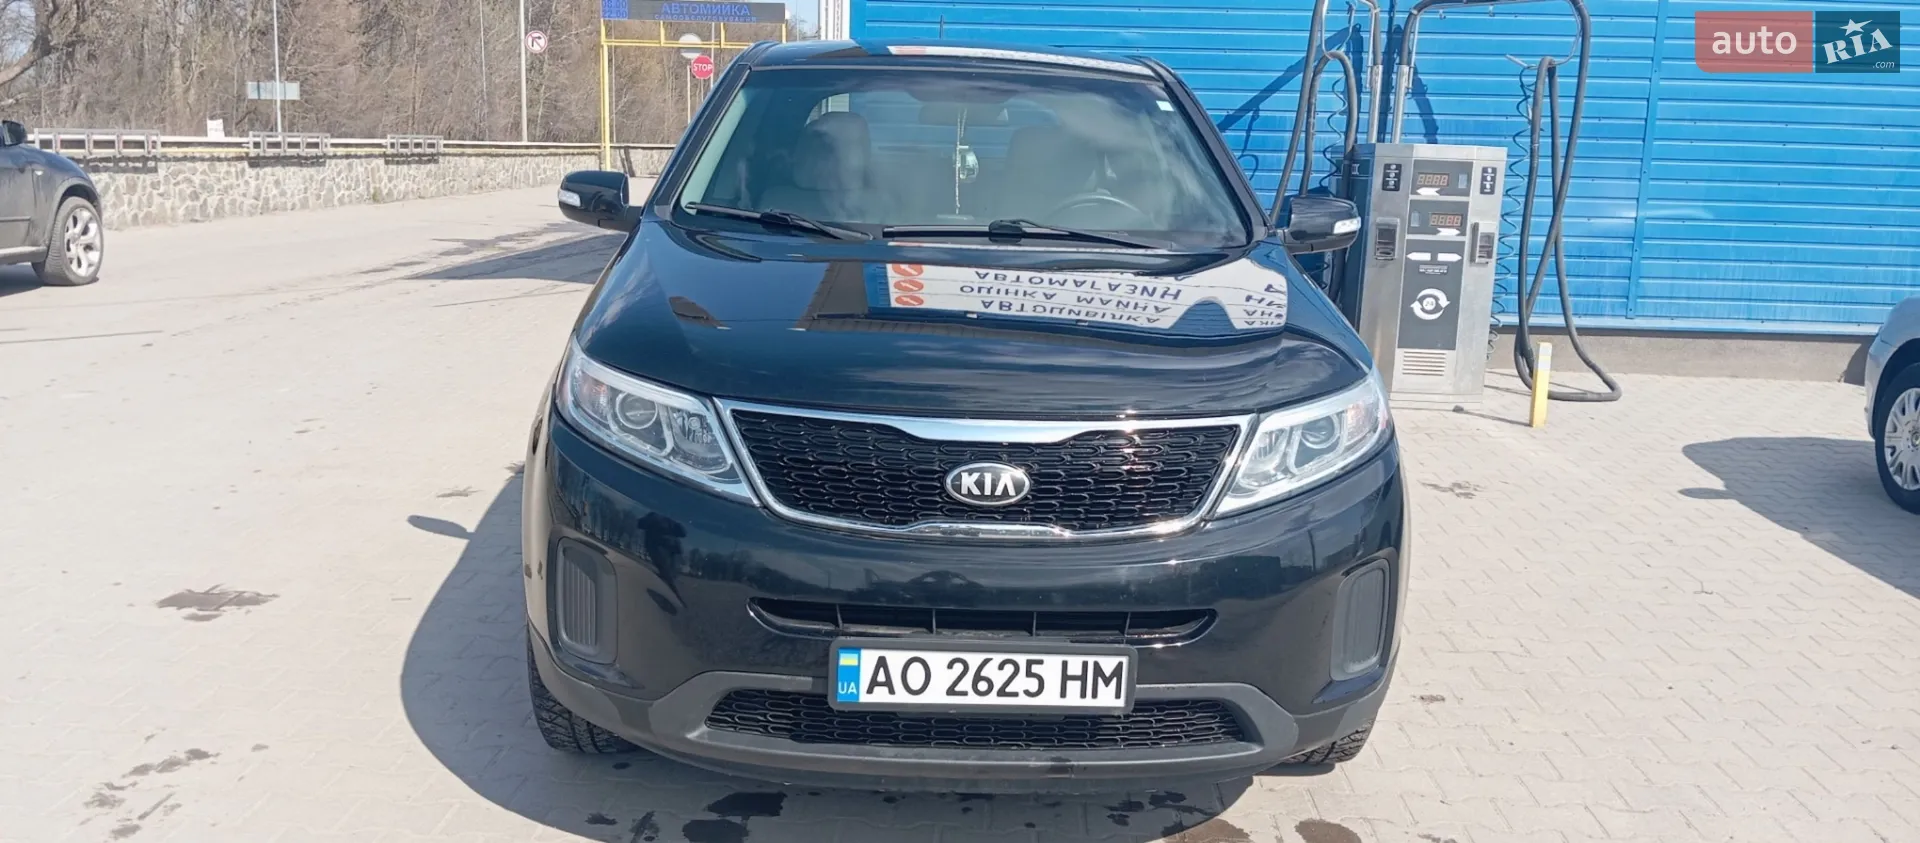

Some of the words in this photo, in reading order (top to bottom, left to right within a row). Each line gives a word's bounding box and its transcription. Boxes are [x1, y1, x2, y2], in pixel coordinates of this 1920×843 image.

[661, 3, 751, 16] АВТОМИЙКА
[693, 63, 713, 72] STOP
[960, 471, 1017, 497] KIA
[945, 656, 1046, 698] 2625
[838, 683, 858, 695] UA
